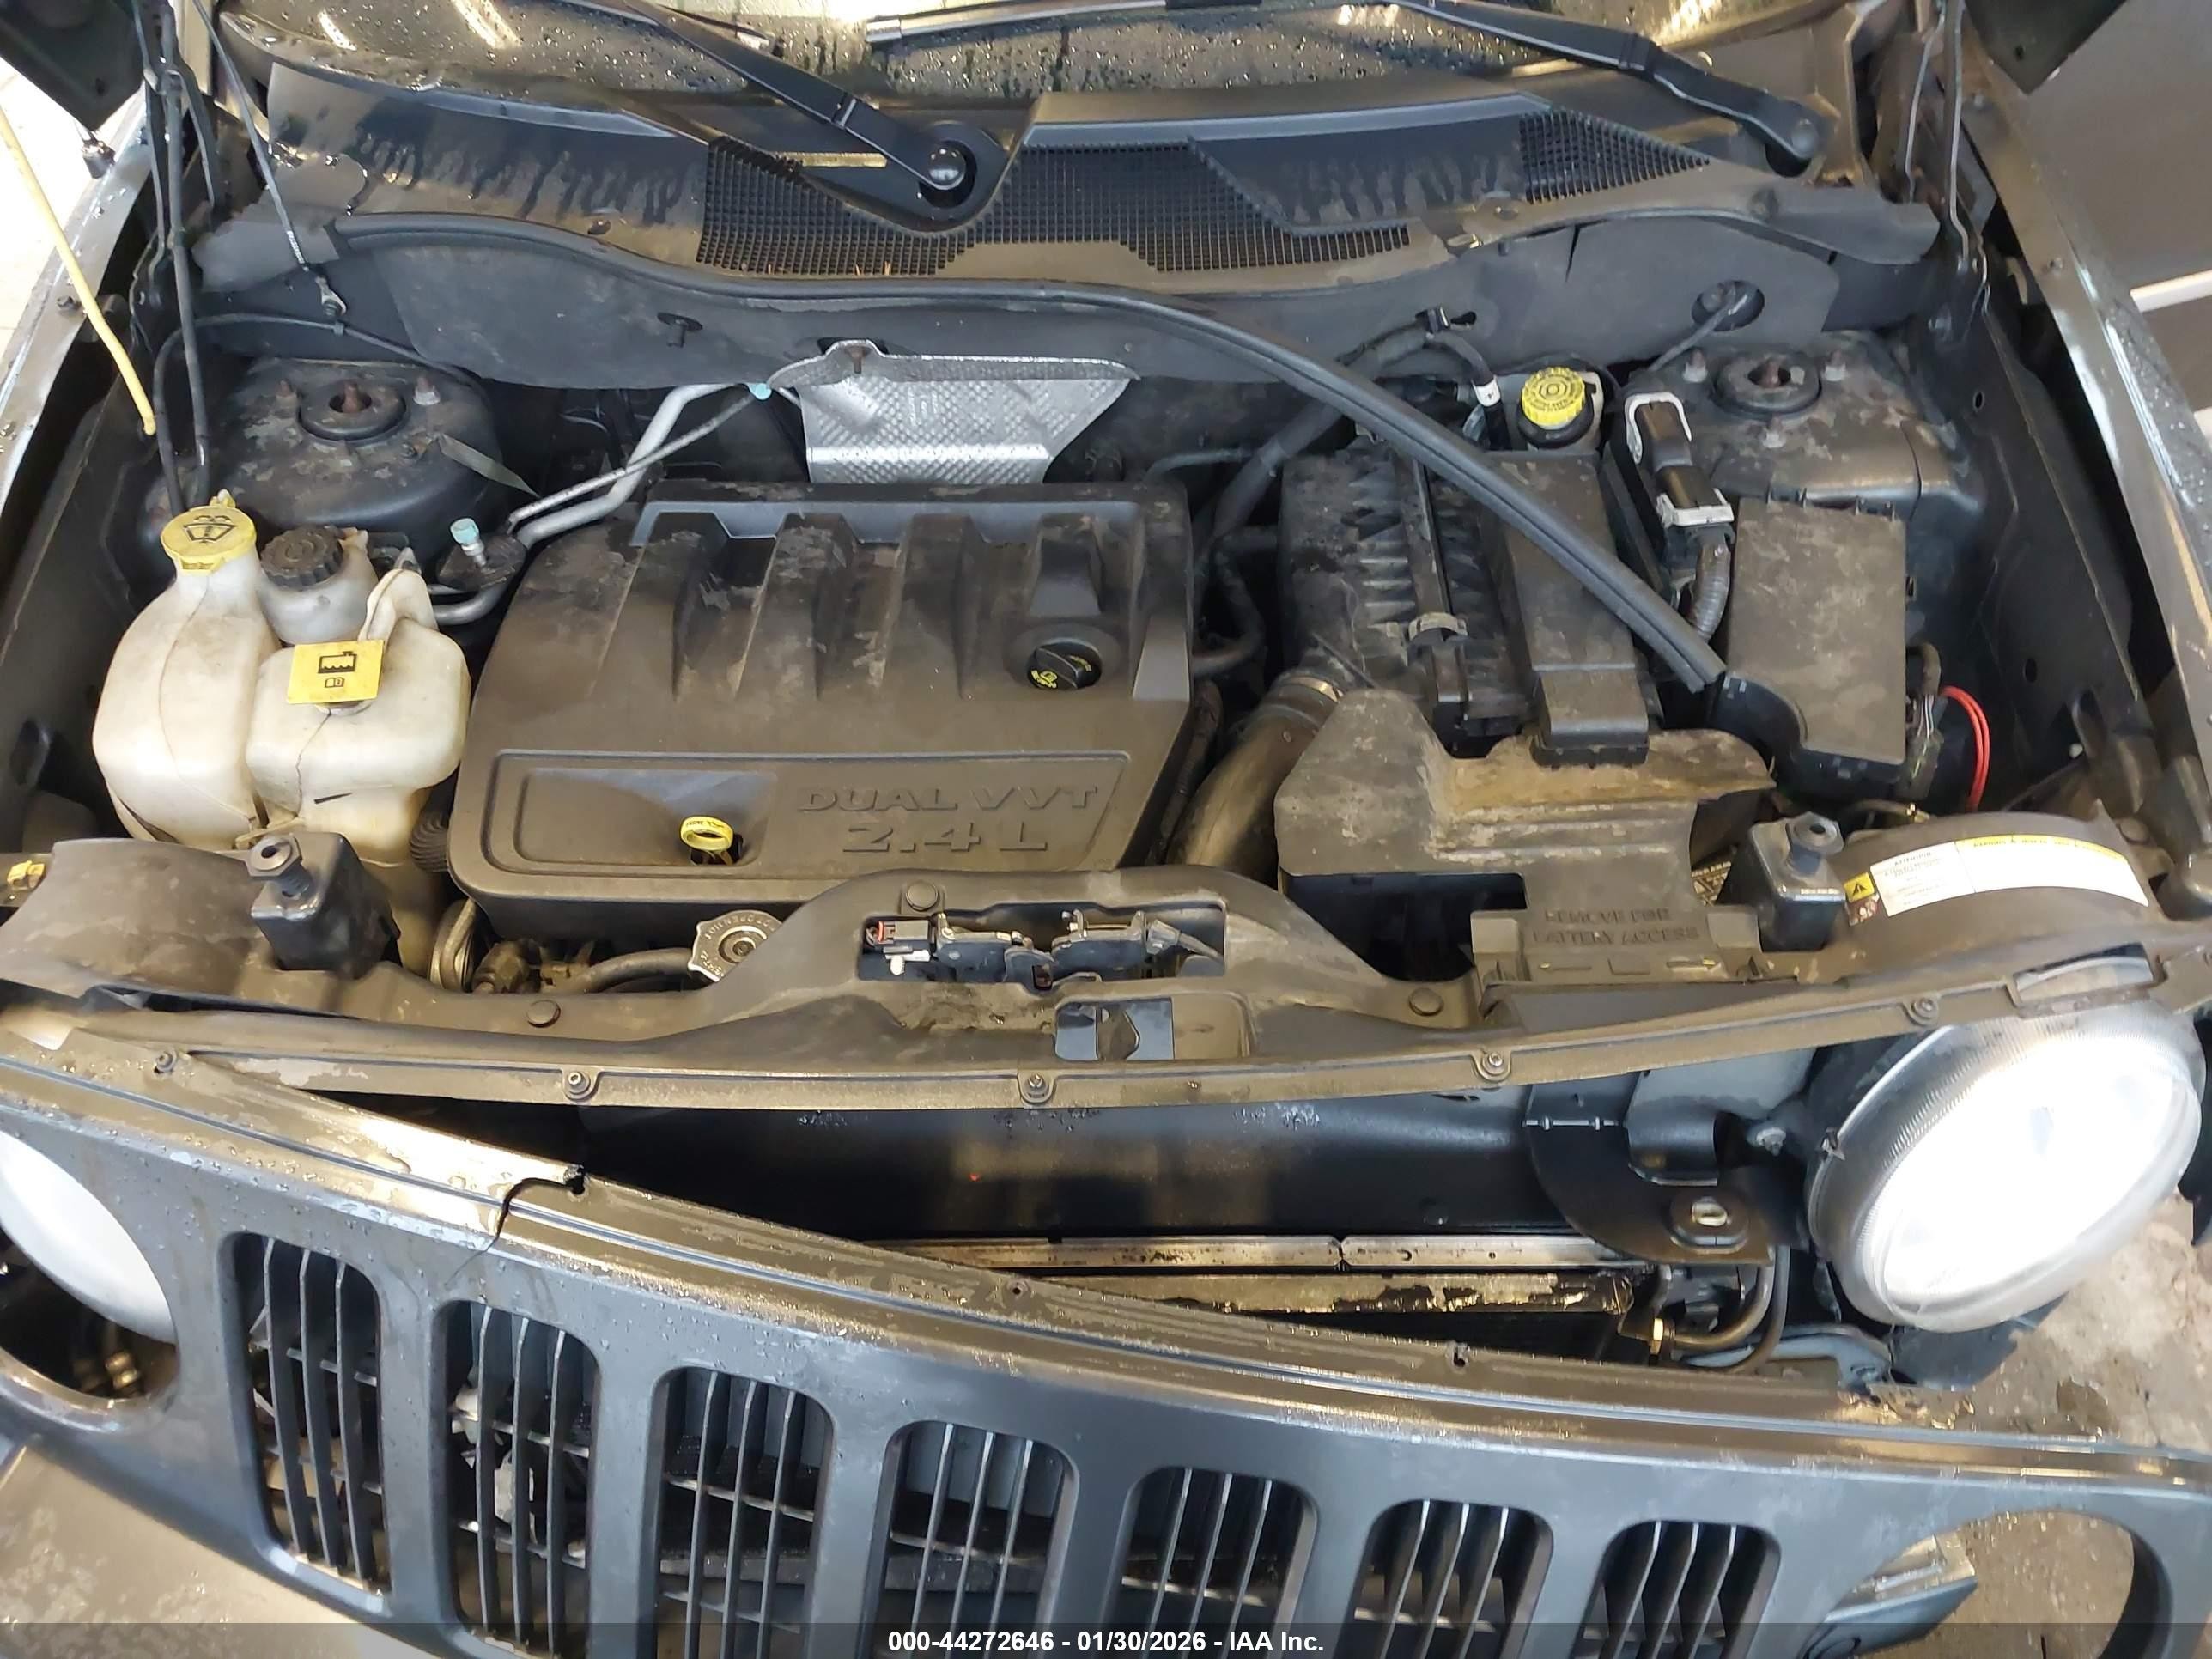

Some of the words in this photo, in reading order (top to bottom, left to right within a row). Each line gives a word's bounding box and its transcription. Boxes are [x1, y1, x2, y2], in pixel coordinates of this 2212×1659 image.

[798, 787, 958, 811] DUAL
[970, 785, 1098, 810] VVT
[1631, 908, 1671, 923] FOR
[1533, 930, 1614, 945] BATTERY
[1622, 927, 1699, 945] ACCESS
